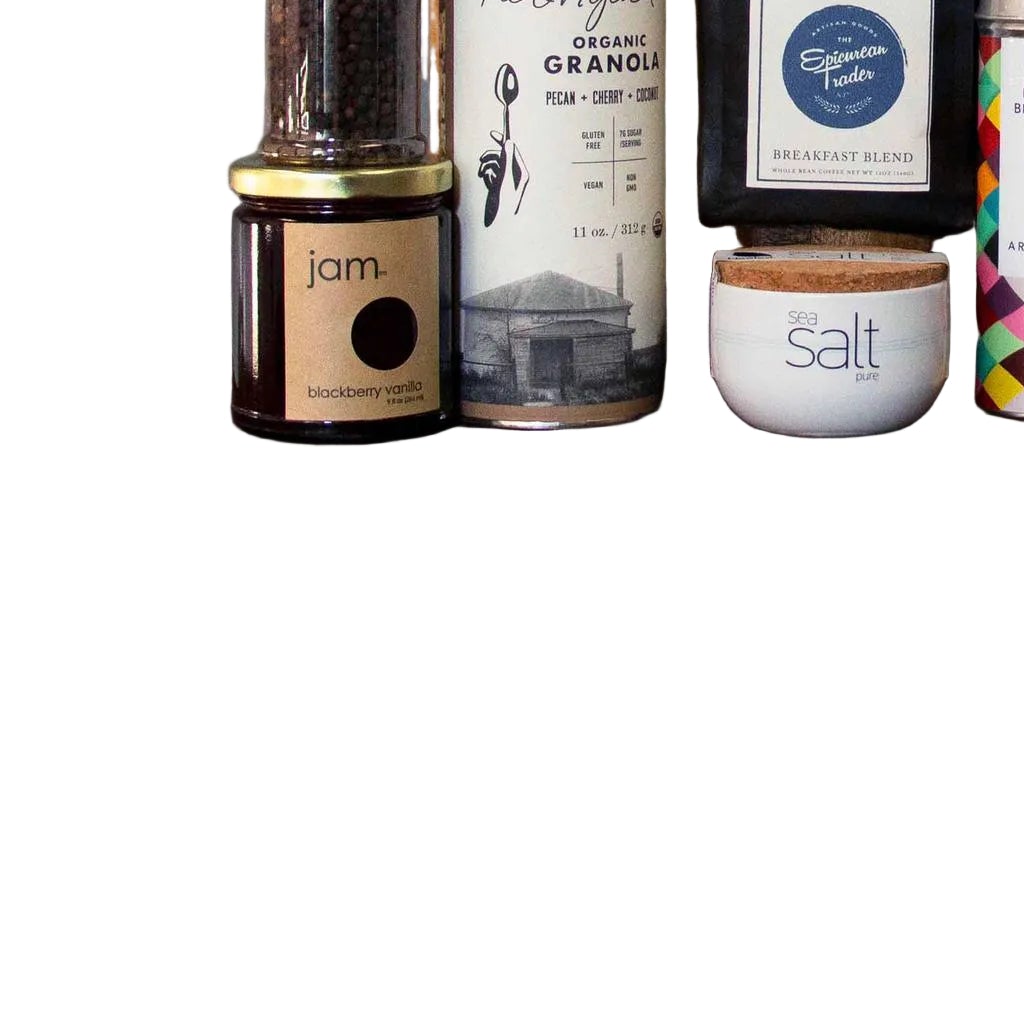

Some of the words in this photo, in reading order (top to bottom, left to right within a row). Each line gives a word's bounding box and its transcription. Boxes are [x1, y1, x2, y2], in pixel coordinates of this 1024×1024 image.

[572, 34, 647, 49] ORGANIC
[543, 51, 660, 74] GRANOLA
[800, 45, 889, 72] Epicurean
[813, 64, 876, 91] Trader
[545, 91, 576, 106] PECAN
[592, 89, 624, 105] CHERRY
[636, 86, 659, 103] COCONUT
[581, 131, 605, 140] GLUTEN
[626, 128, 642, 137] SUGAR
[585, 141, 601, 150] FREE
[772, 149, 859, 162] BREAKFAST
[863, 151, 914, 163] BLEND
[626, 173, 637, 181] NON
[583, 181, 604, 190] VEGAN
[626, 183, 637, 192] GMO
[573, 226, 587, 238] 11
[591, 227, 609, 238] oz.
[620, 223, 640, 236] 312
[306, 249, 379, 289] jam
[787, 309, 818, 326] sea
[785, 311, 880, 370] salt
[855, 371, 880, 383] pure
[307, 385, 382, 399] blackberry
[384, 380, 423, 395] vanilla
